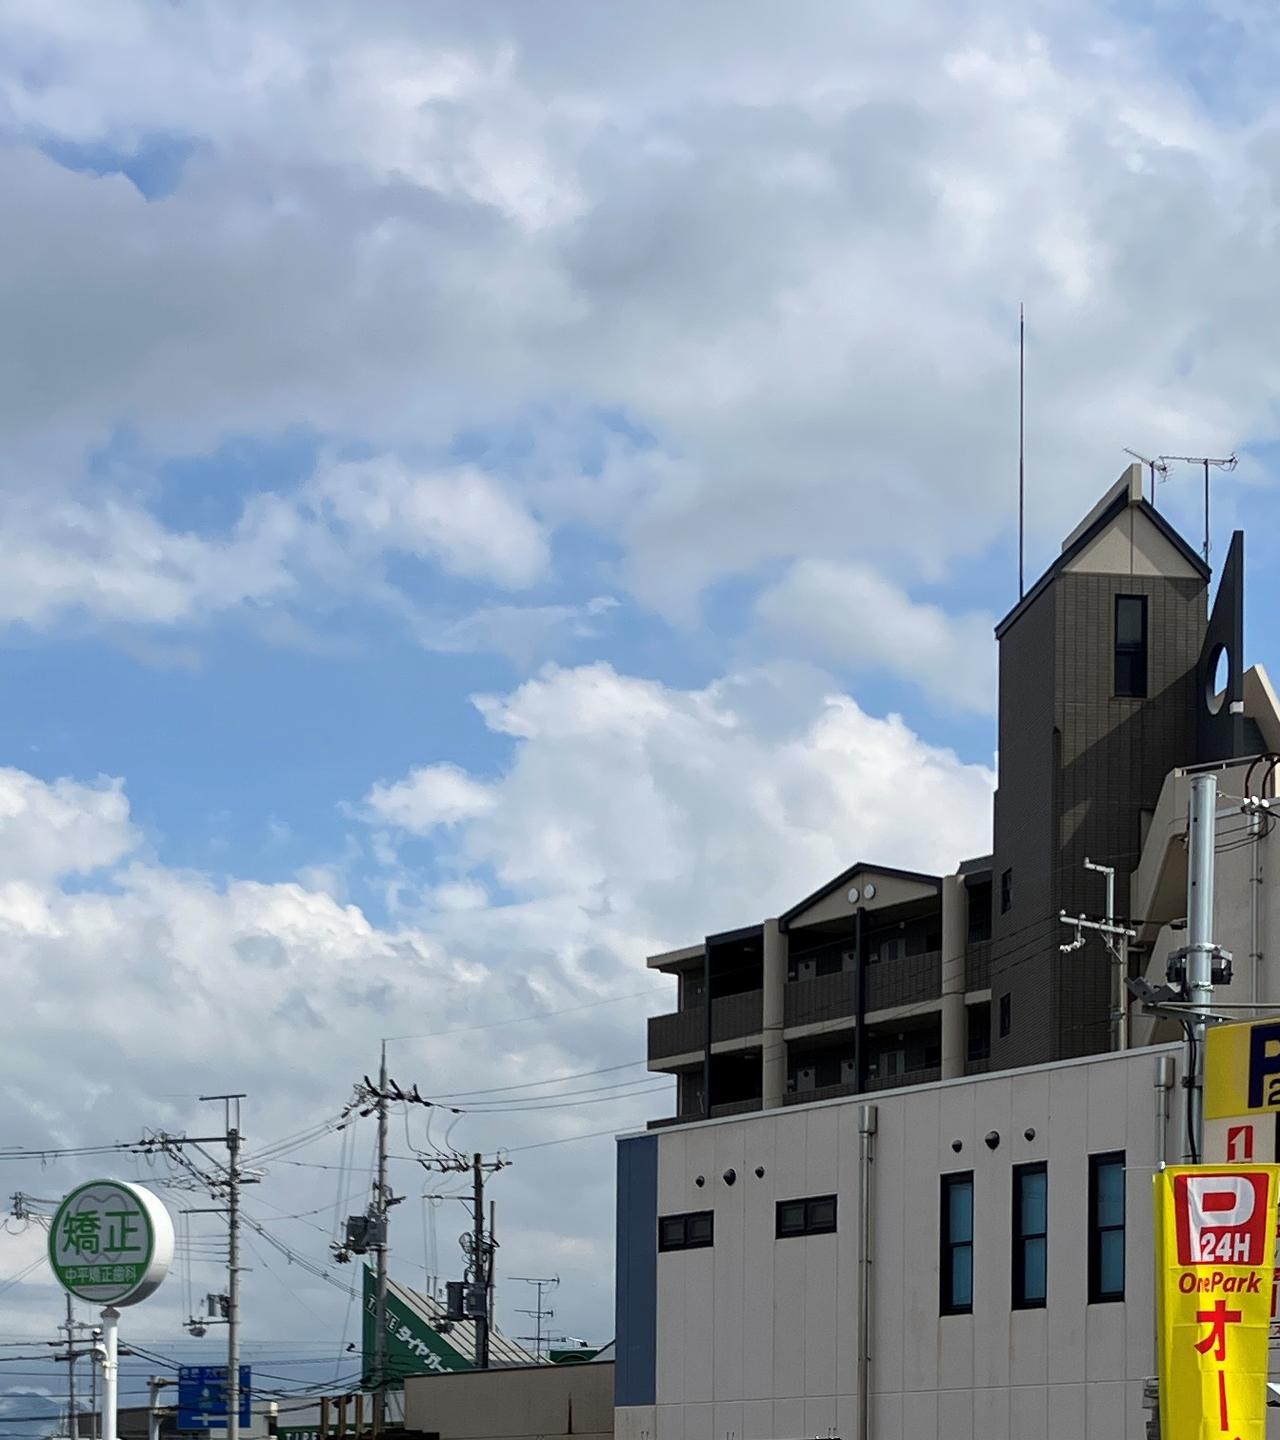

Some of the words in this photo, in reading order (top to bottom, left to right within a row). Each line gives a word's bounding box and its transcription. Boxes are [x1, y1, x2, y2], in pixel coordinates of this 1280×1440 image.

[62, 1210, 142, 1256] 矯正
[1186, 1176, 1256, 1263] P
[1200, 1232, 1251, 1263] 24H
[64, 1264, 137, 1285] 中平矯正歯科
[1178, 1270, 1263, 1294] OnePark
